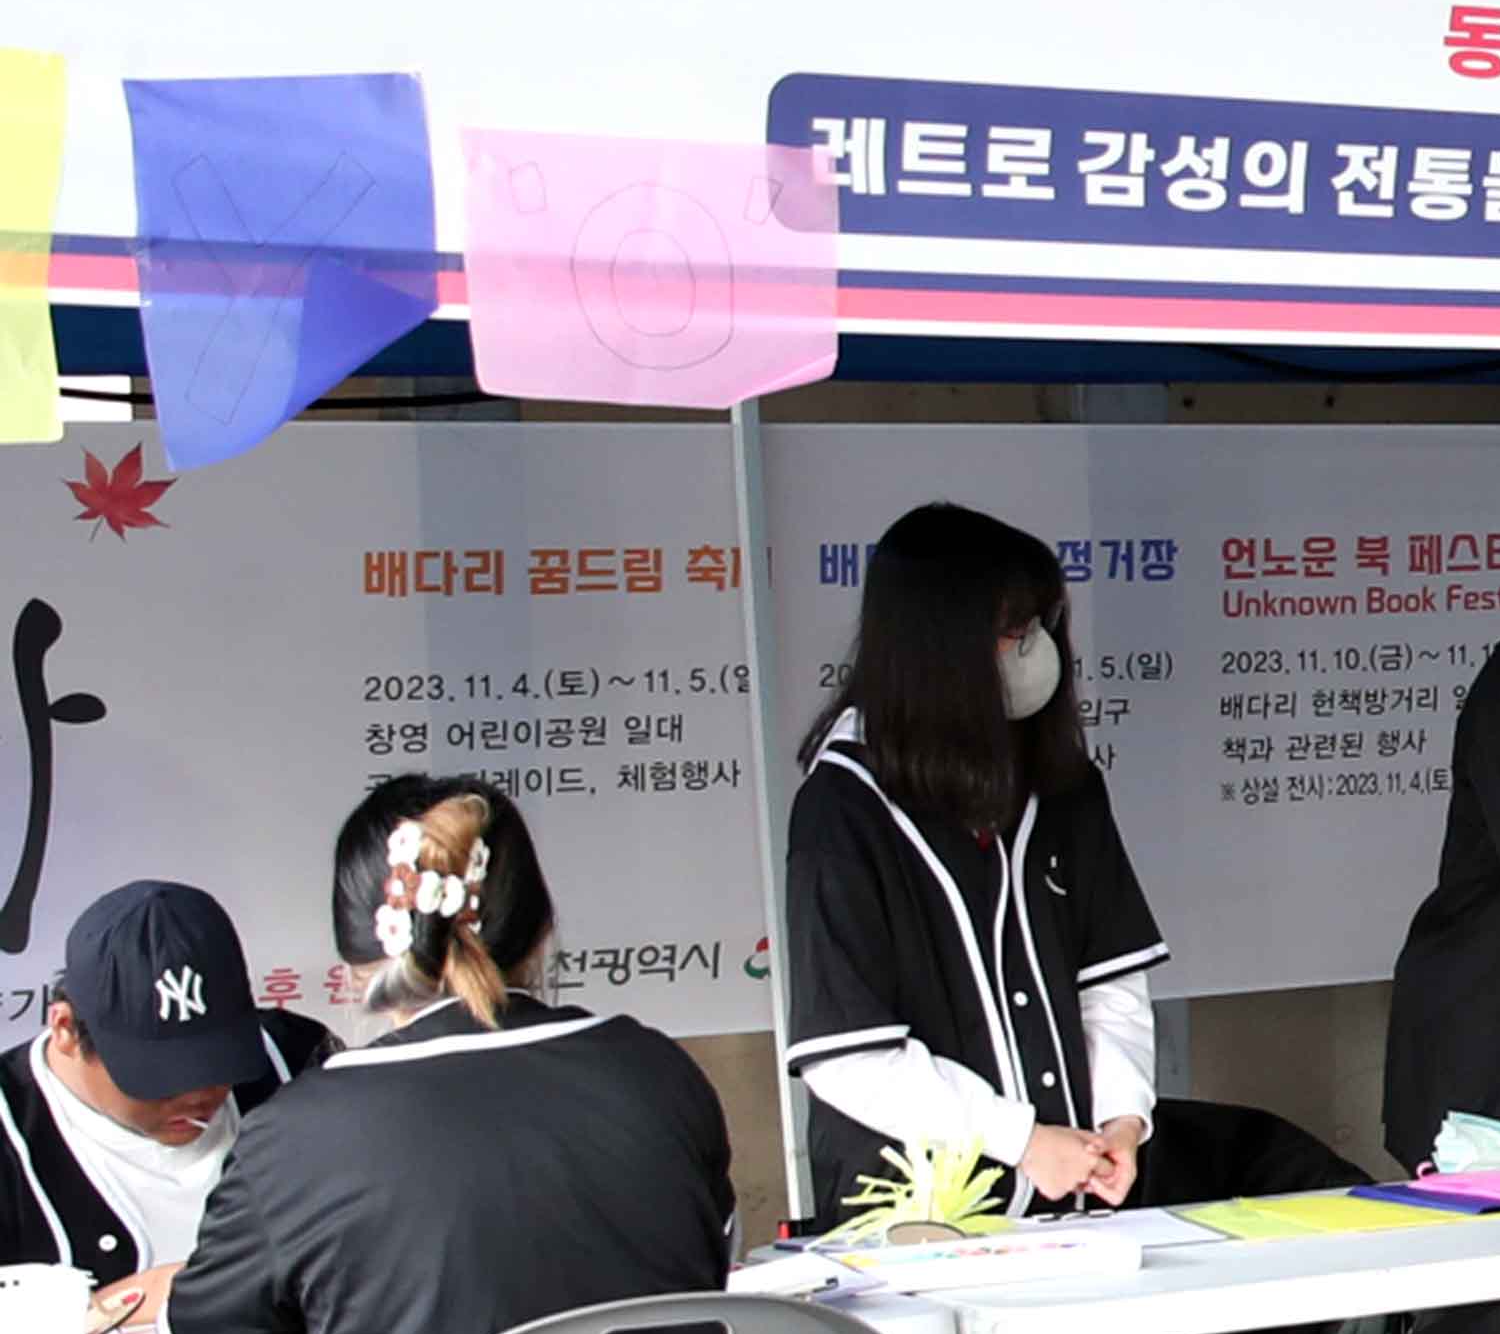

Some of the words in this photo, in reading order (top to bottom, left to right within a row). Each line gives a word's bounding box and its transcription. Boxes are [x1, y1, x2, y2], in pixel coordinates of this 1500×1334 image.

[808, 116, 1056, 202] 레트로
[1075, 128, 1307, 215] 감성의
[363, 549, 504, 597] 배다리
[528, 547, 663, 595] 꿈드림
[1056, 539, 1179, 583] 정거장
[1221, 535, 1337, 581] 언노운
[1355, 535, 1391, 578] 북
[1223, 589, 1357, 618] Unknown
[1366, 586, 1437, 614] Book
[1220, 693, 1297, 720] 배다리
[1312, 687, 1438, 718] 헌책방거리
[365, 721, 429, 756] 창영
[447, 714, 608, 751] 어린이공원
[624, 713, 684, 746] 일대
[1224, 736, 1274, 763] 책과
[1287, 732, 1364, 761] 관련된
[1377, 729, 1427, 757] 행사
[617, 759, 742, 793] 체험행사
[1241, 777, 1280, 805] 상설
[553, 942, 721, 989] 천광역시
[155, 965, 207, 1022] NY
